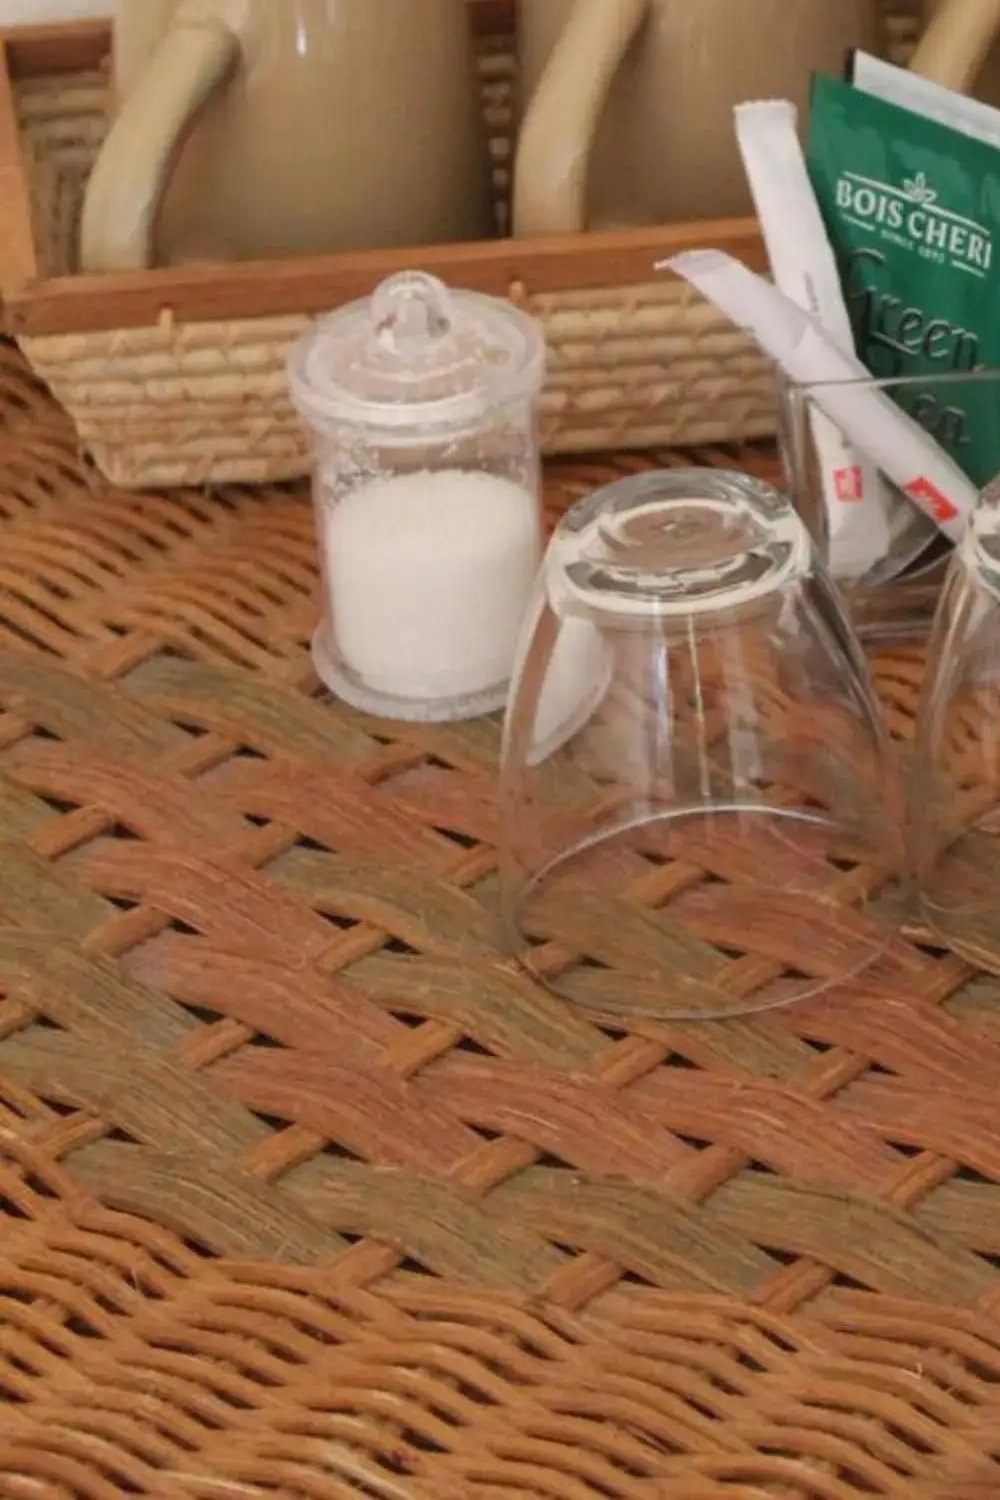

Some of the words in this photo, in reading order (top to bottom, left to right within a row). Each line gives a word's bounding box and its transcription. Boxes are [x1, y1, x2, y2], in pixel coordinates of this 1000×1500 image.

[836, 179, 904, 228] BOIS
[907, 211, 992, 268] CHERI
[844, 247, 986, 373] Green
